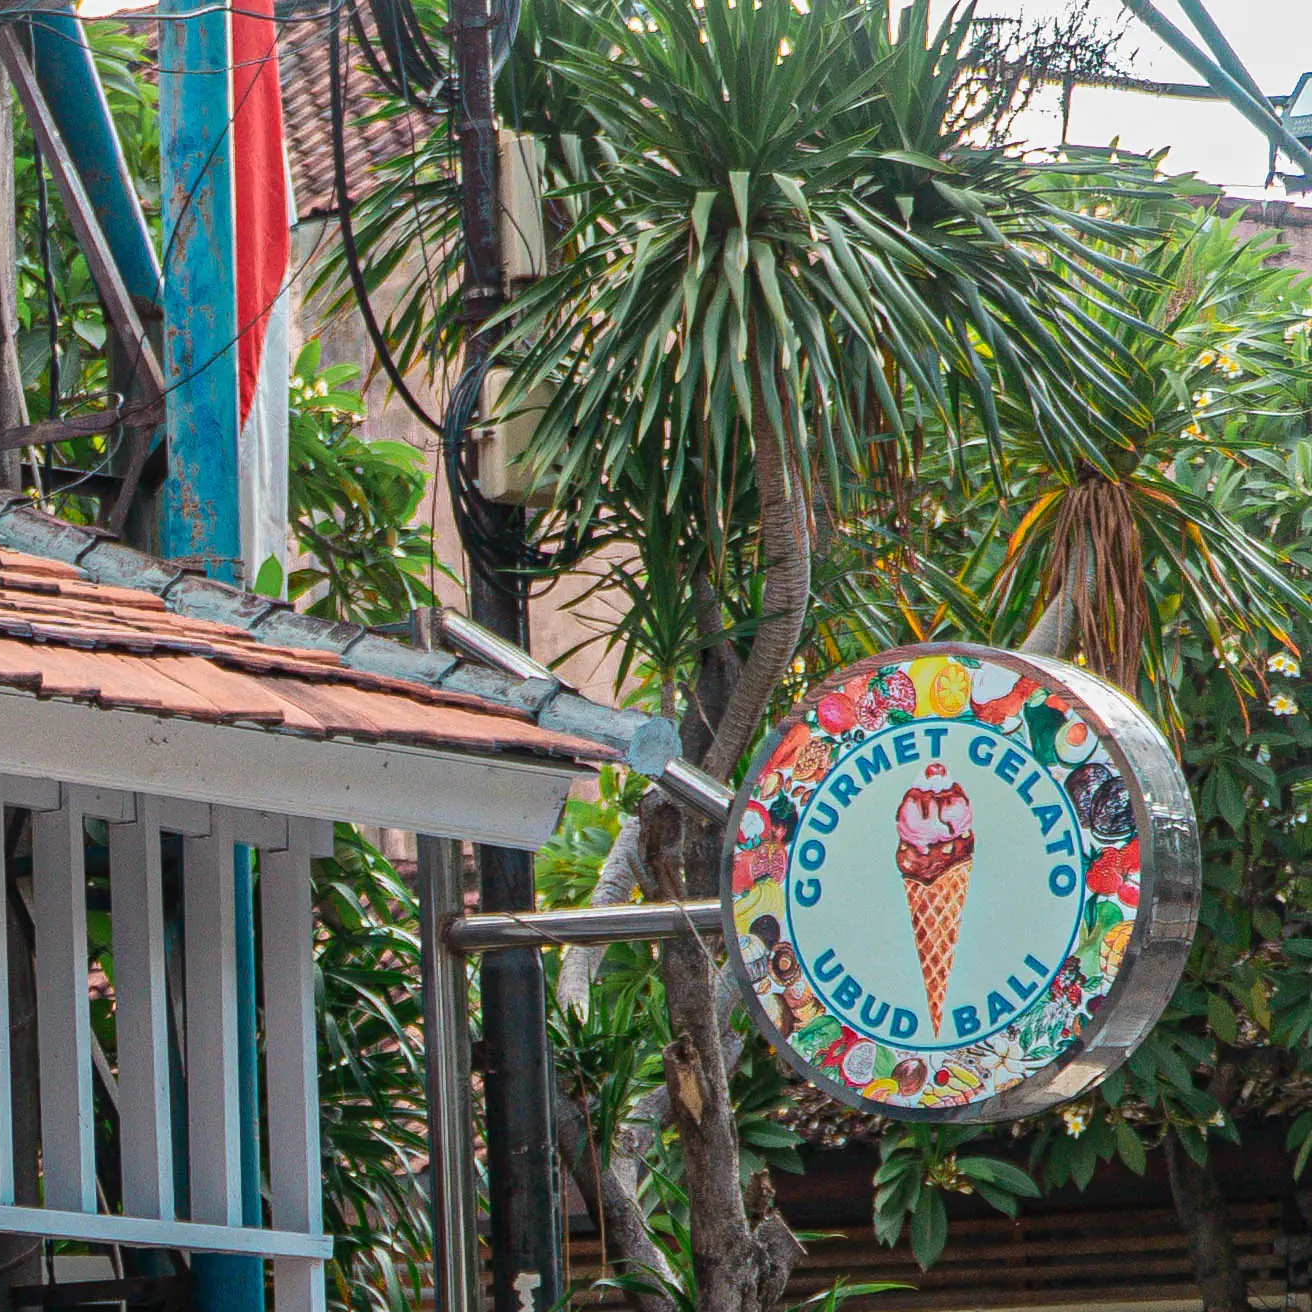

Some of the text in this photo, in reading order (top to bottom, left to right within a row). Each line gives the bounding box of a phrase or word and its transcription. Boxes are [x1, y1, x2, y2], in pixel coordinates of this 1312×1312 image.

[795, 727, 1078, 908] GOURMET GELATO
[813, 947, 1050, 1040] UBUD BALI
